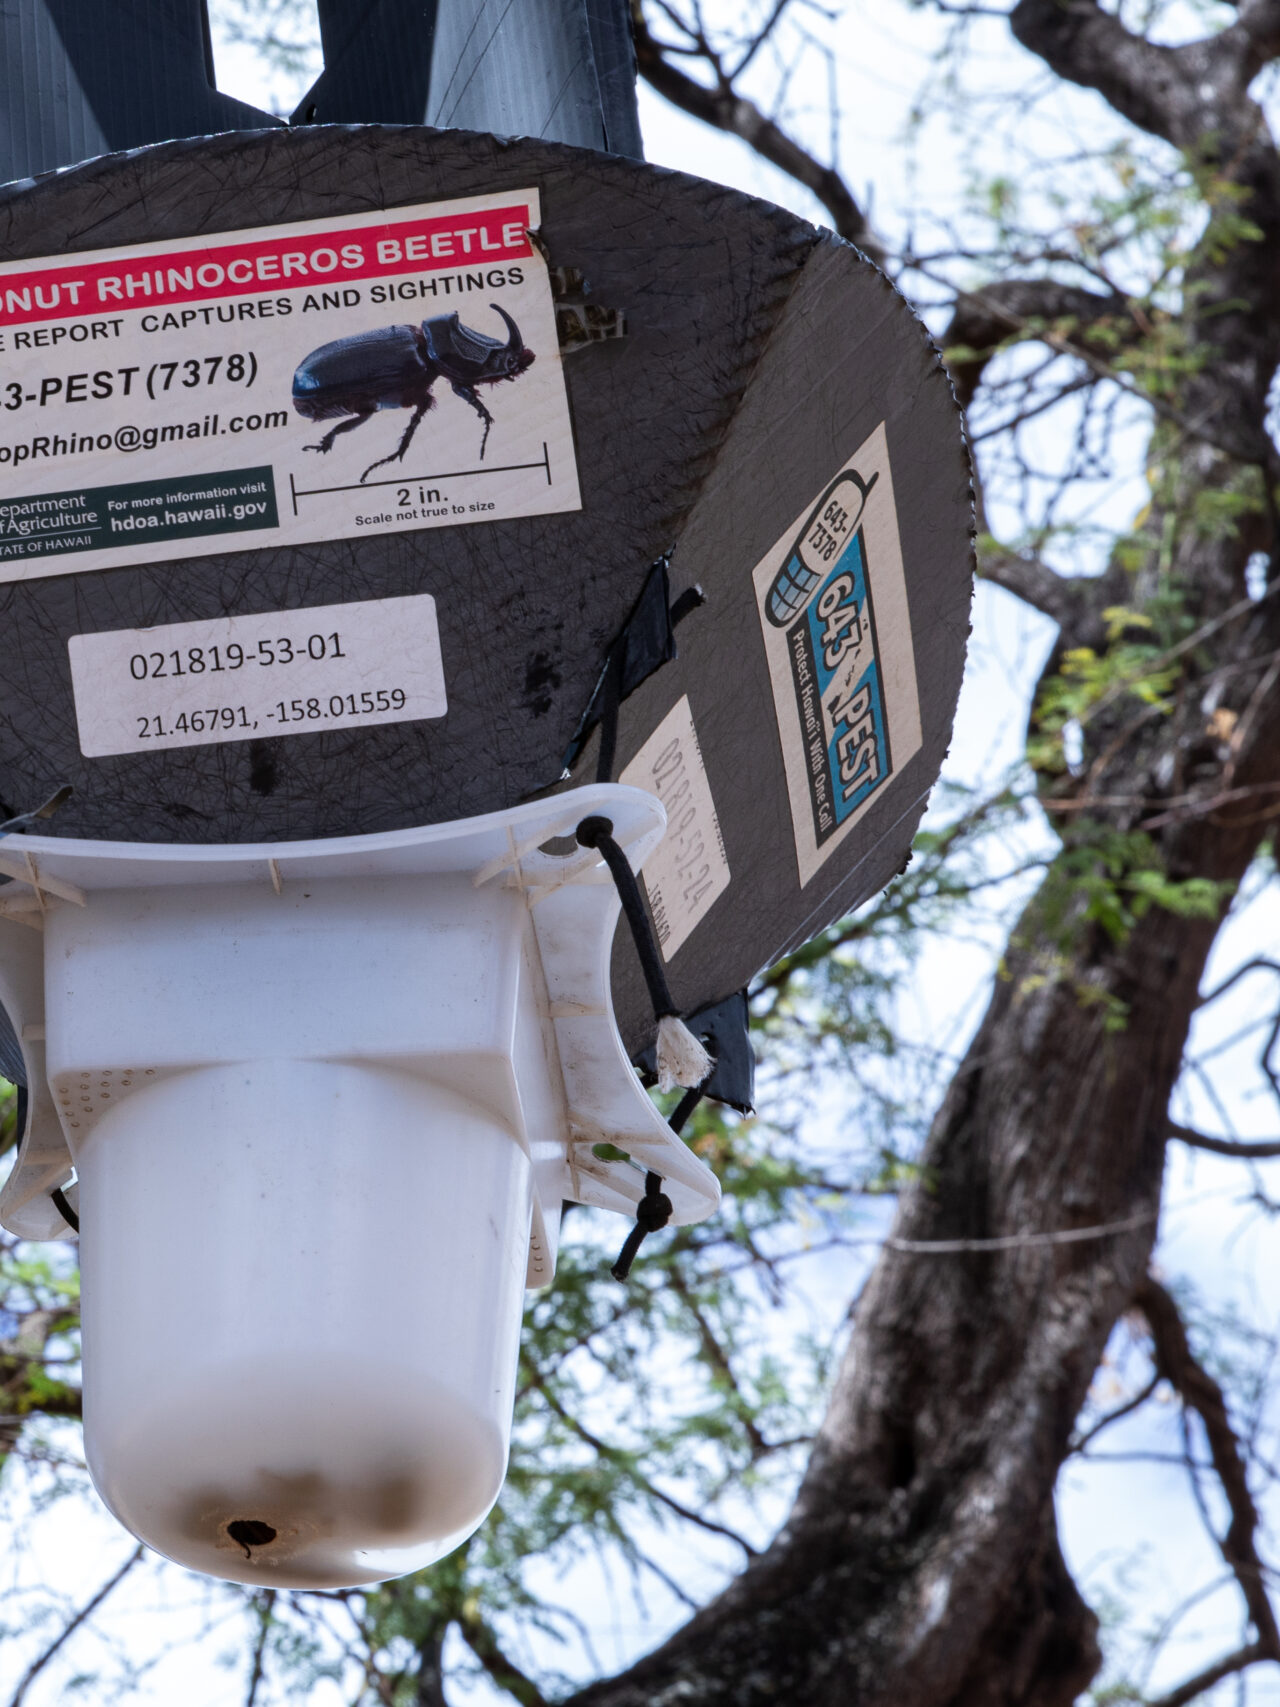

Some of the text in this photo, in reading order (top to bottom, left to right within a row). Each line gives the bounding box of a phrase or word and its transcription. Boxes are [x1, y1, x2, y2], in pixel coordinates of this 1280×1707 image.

[97, 244, 365, 302] RHINOCEROS
[376, 222, 525, 265] BEETLE
[14, 318, 124, 350] REPORT
[140, 298, 292, 332] CAPTURES
[302, 288, 361, 313] AND
[370, 266, 524, 304] SIGHTINGS
[107, 482, 267, 511] For more information visit
[355, 500, 495, 526] Scale not true to size
[396, 486, 448, 507] 2 in.
[7, 512, 98, 536] Agriculture
[111, 502, 267, 532] hdoa.hawaii.gov
[823, 500, 848, 533] 643-
[27, 541, 43, 552] OF
[45, 536, 92, 550] HAWAII
[808, 522, 837, 561] 7378
[816, 570, 862, 672] 643
[129, 632, 346, 680] 021819-53-01
[792, 628, 812, 686] Protect
[137, 688, 406, 738] 21.46791, -158.01559
[809, 737, 825, 775] With
[832, 681, 880, 803] PEST
[814, 772, 826, 805] One
[818, 801, 833, 832] Call
